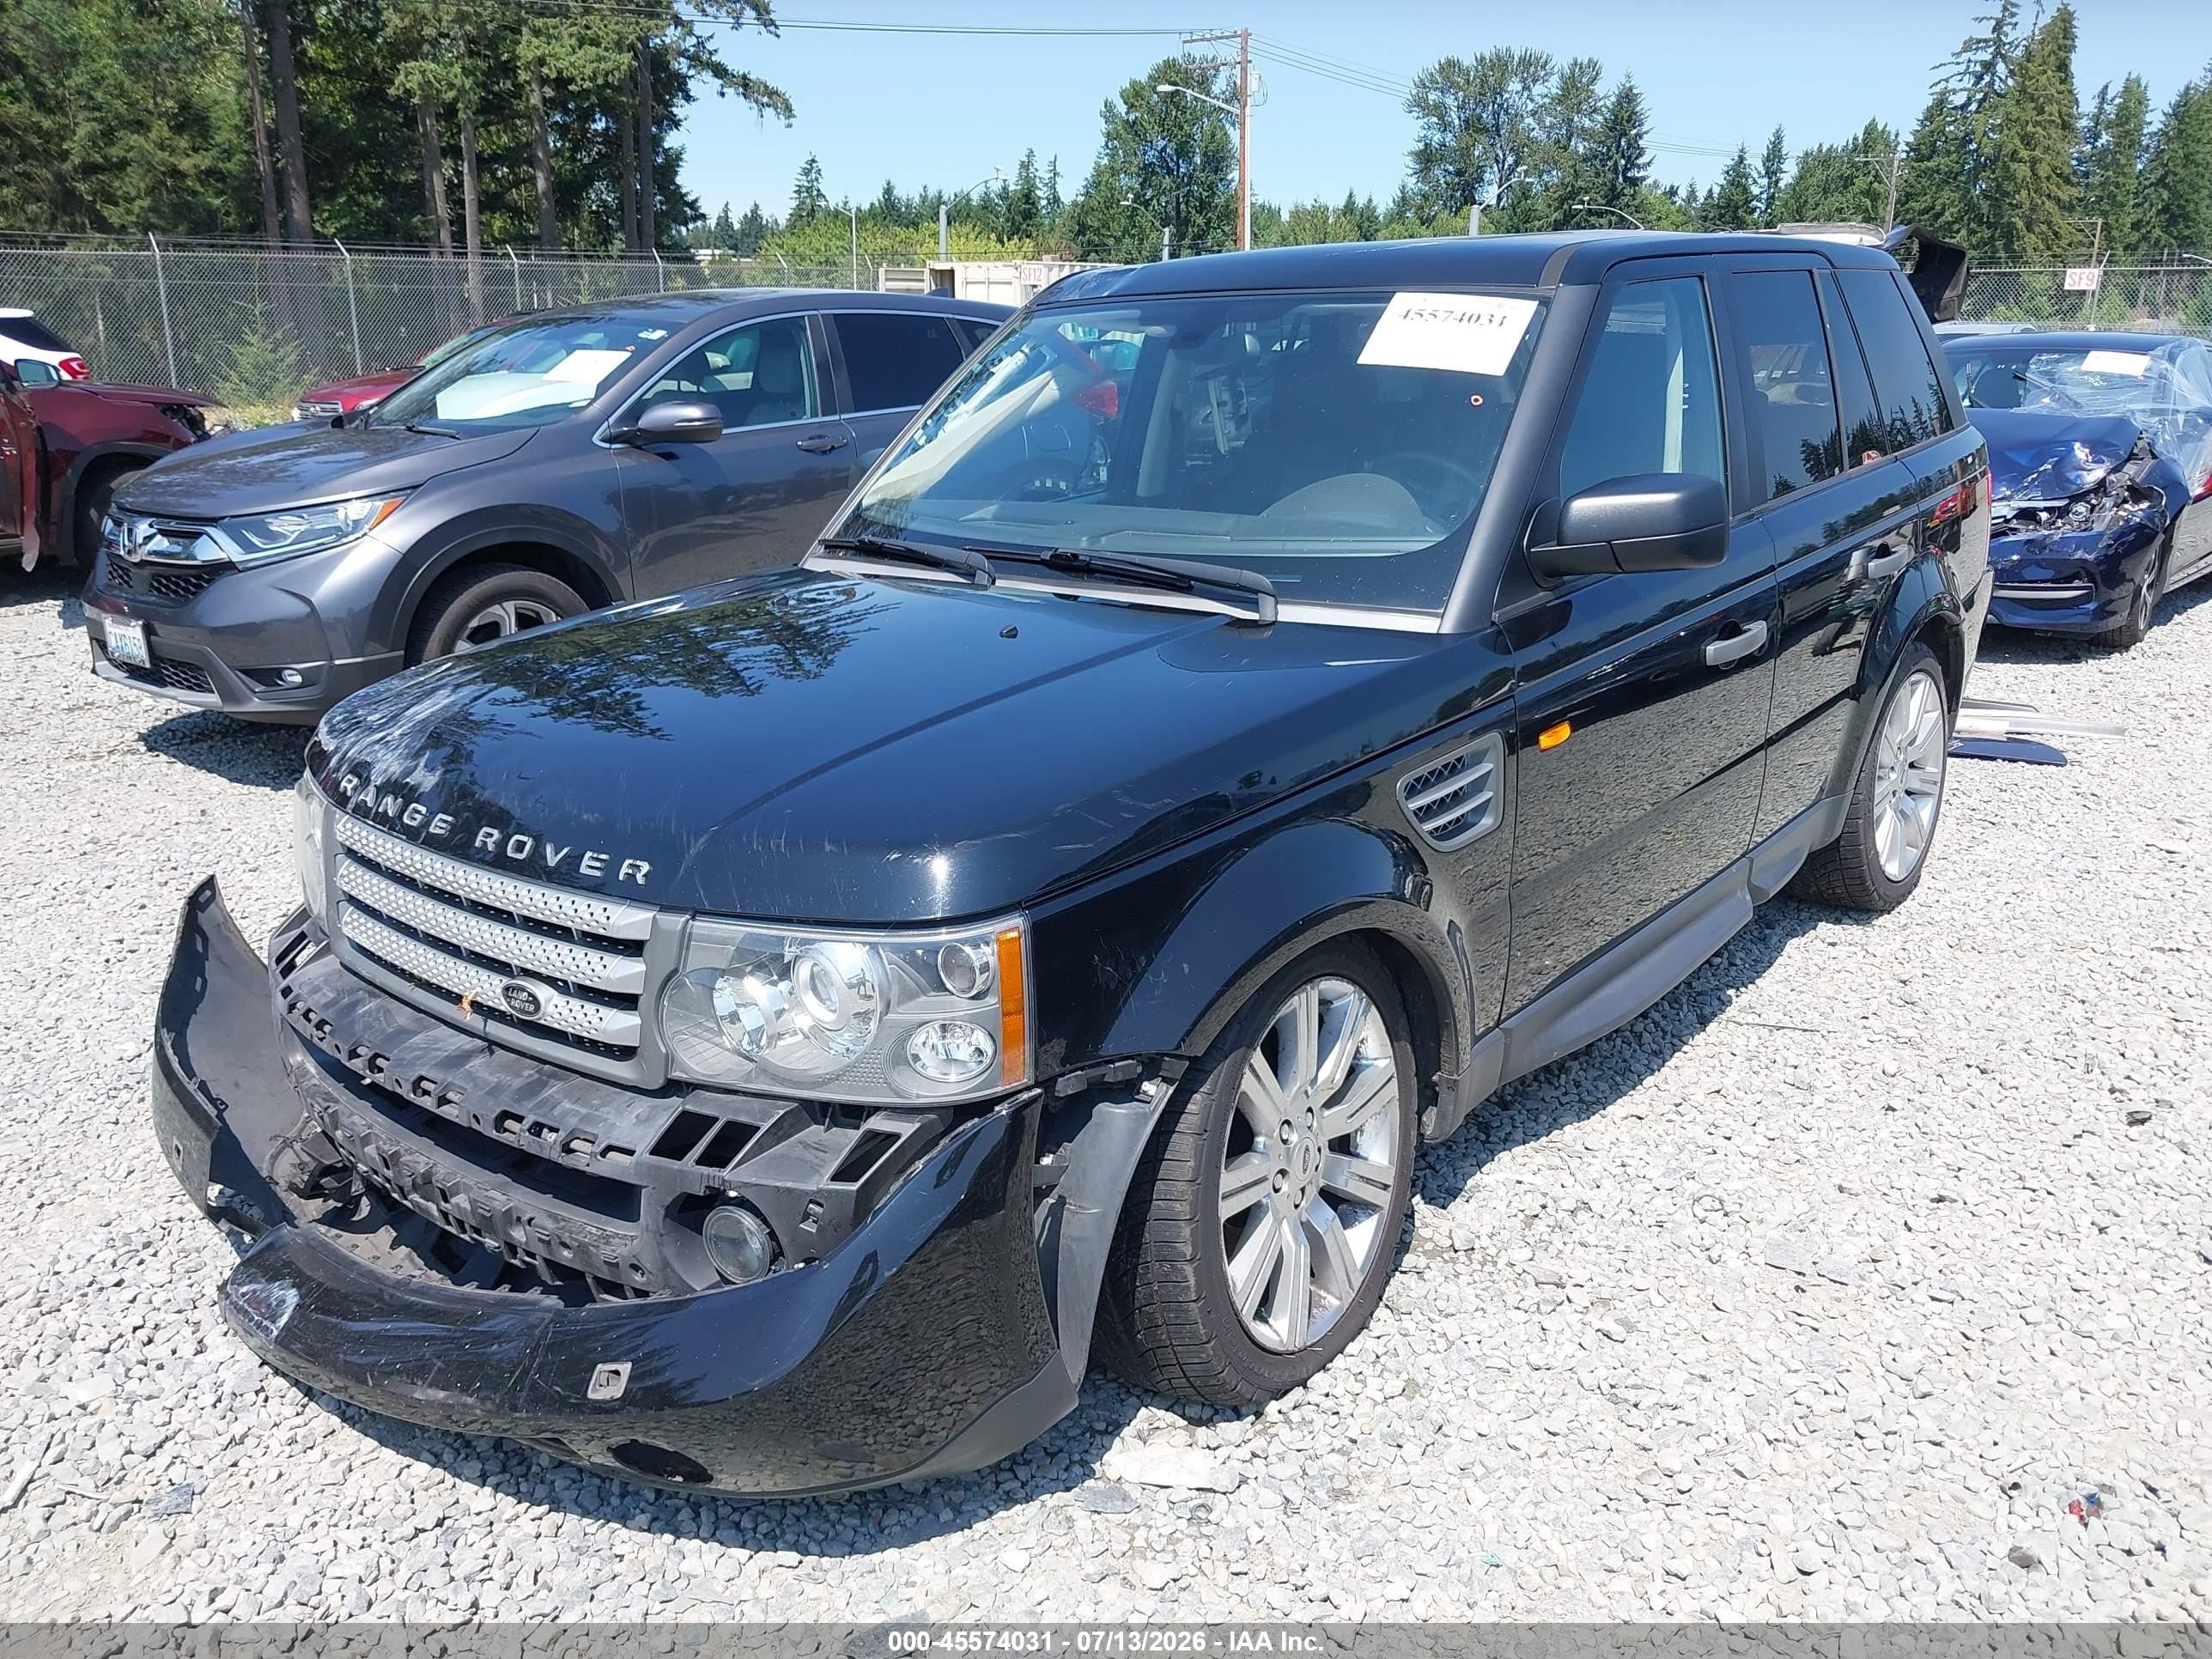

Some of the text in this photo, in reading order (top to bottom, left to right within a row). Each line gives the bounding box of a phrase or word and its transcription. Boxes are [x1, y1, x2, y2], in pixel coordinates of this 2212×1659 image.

[1022, 267, 1042, 282] SF12
[2068, 271, 2095, 287] SF9
[1398, 307, 1508, 327] 45574031
[339, 773, 654, 886] RANGE ROVER
